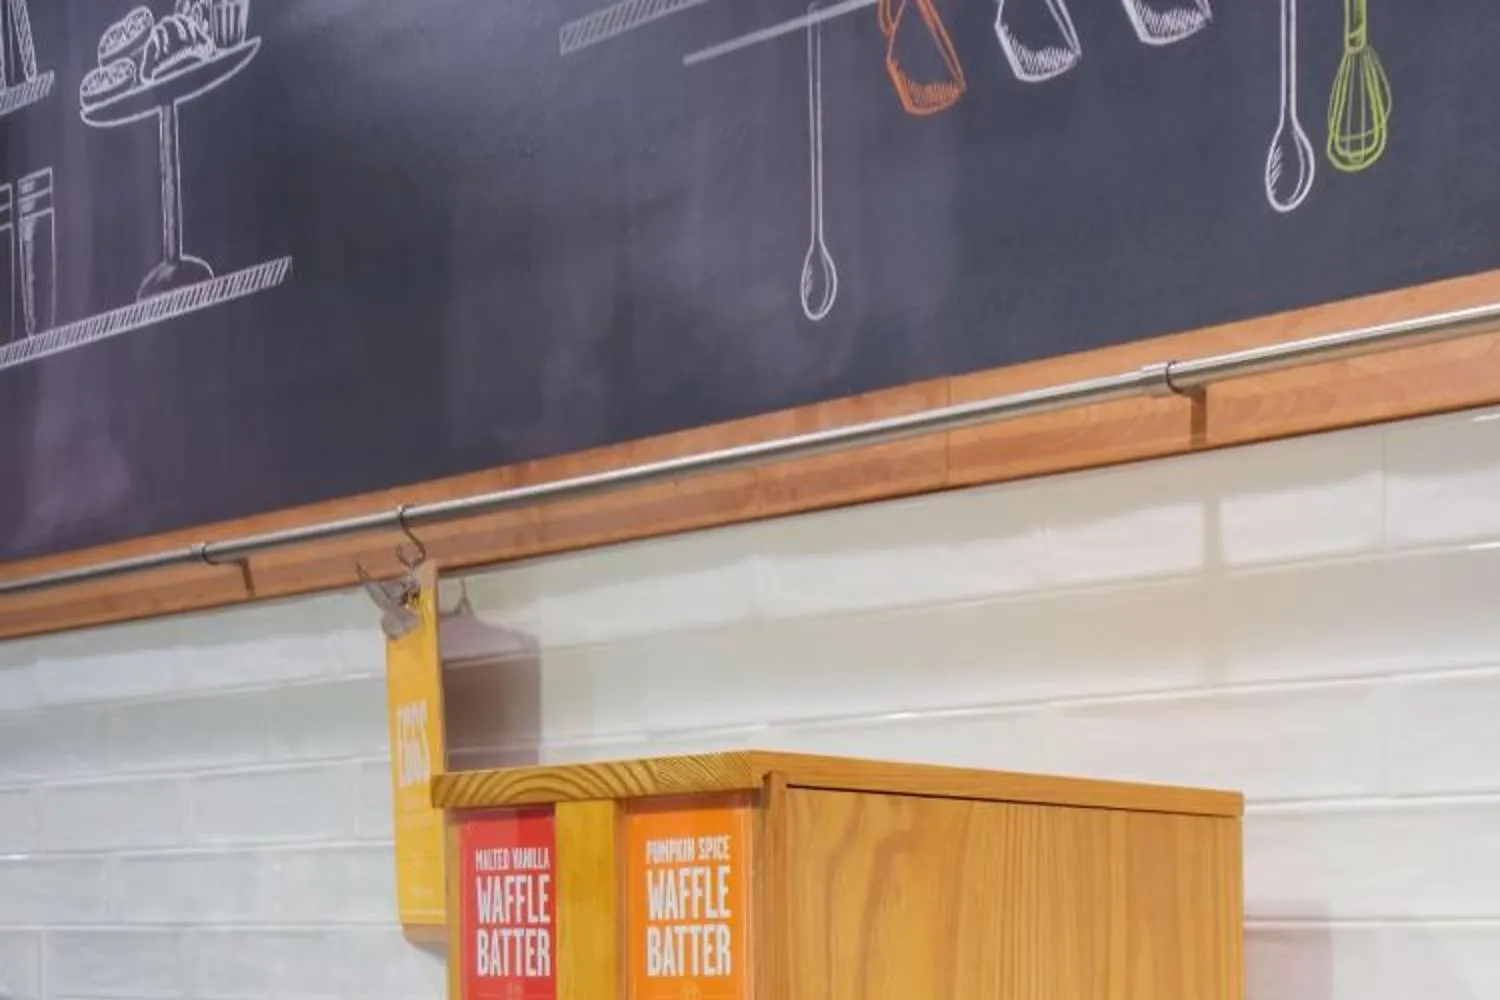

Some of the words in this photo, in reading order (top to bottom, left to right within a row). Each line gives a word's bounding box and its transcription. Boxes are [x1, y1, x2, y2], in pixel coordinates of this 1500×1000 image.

[475, 848, 508, 873] MALTED
[511, 847, 550, 869] VANILLA
[646, 836, 694, 864] PUMPKIN
[699, 834, 732, 860] SPICE
[475, 874, 551, 924] WAFFLE
[647, 865, 731, 921] WAFFLE
[476, 928, 551, 977] BATTER
[646, 924, 732, 977] BATTER
